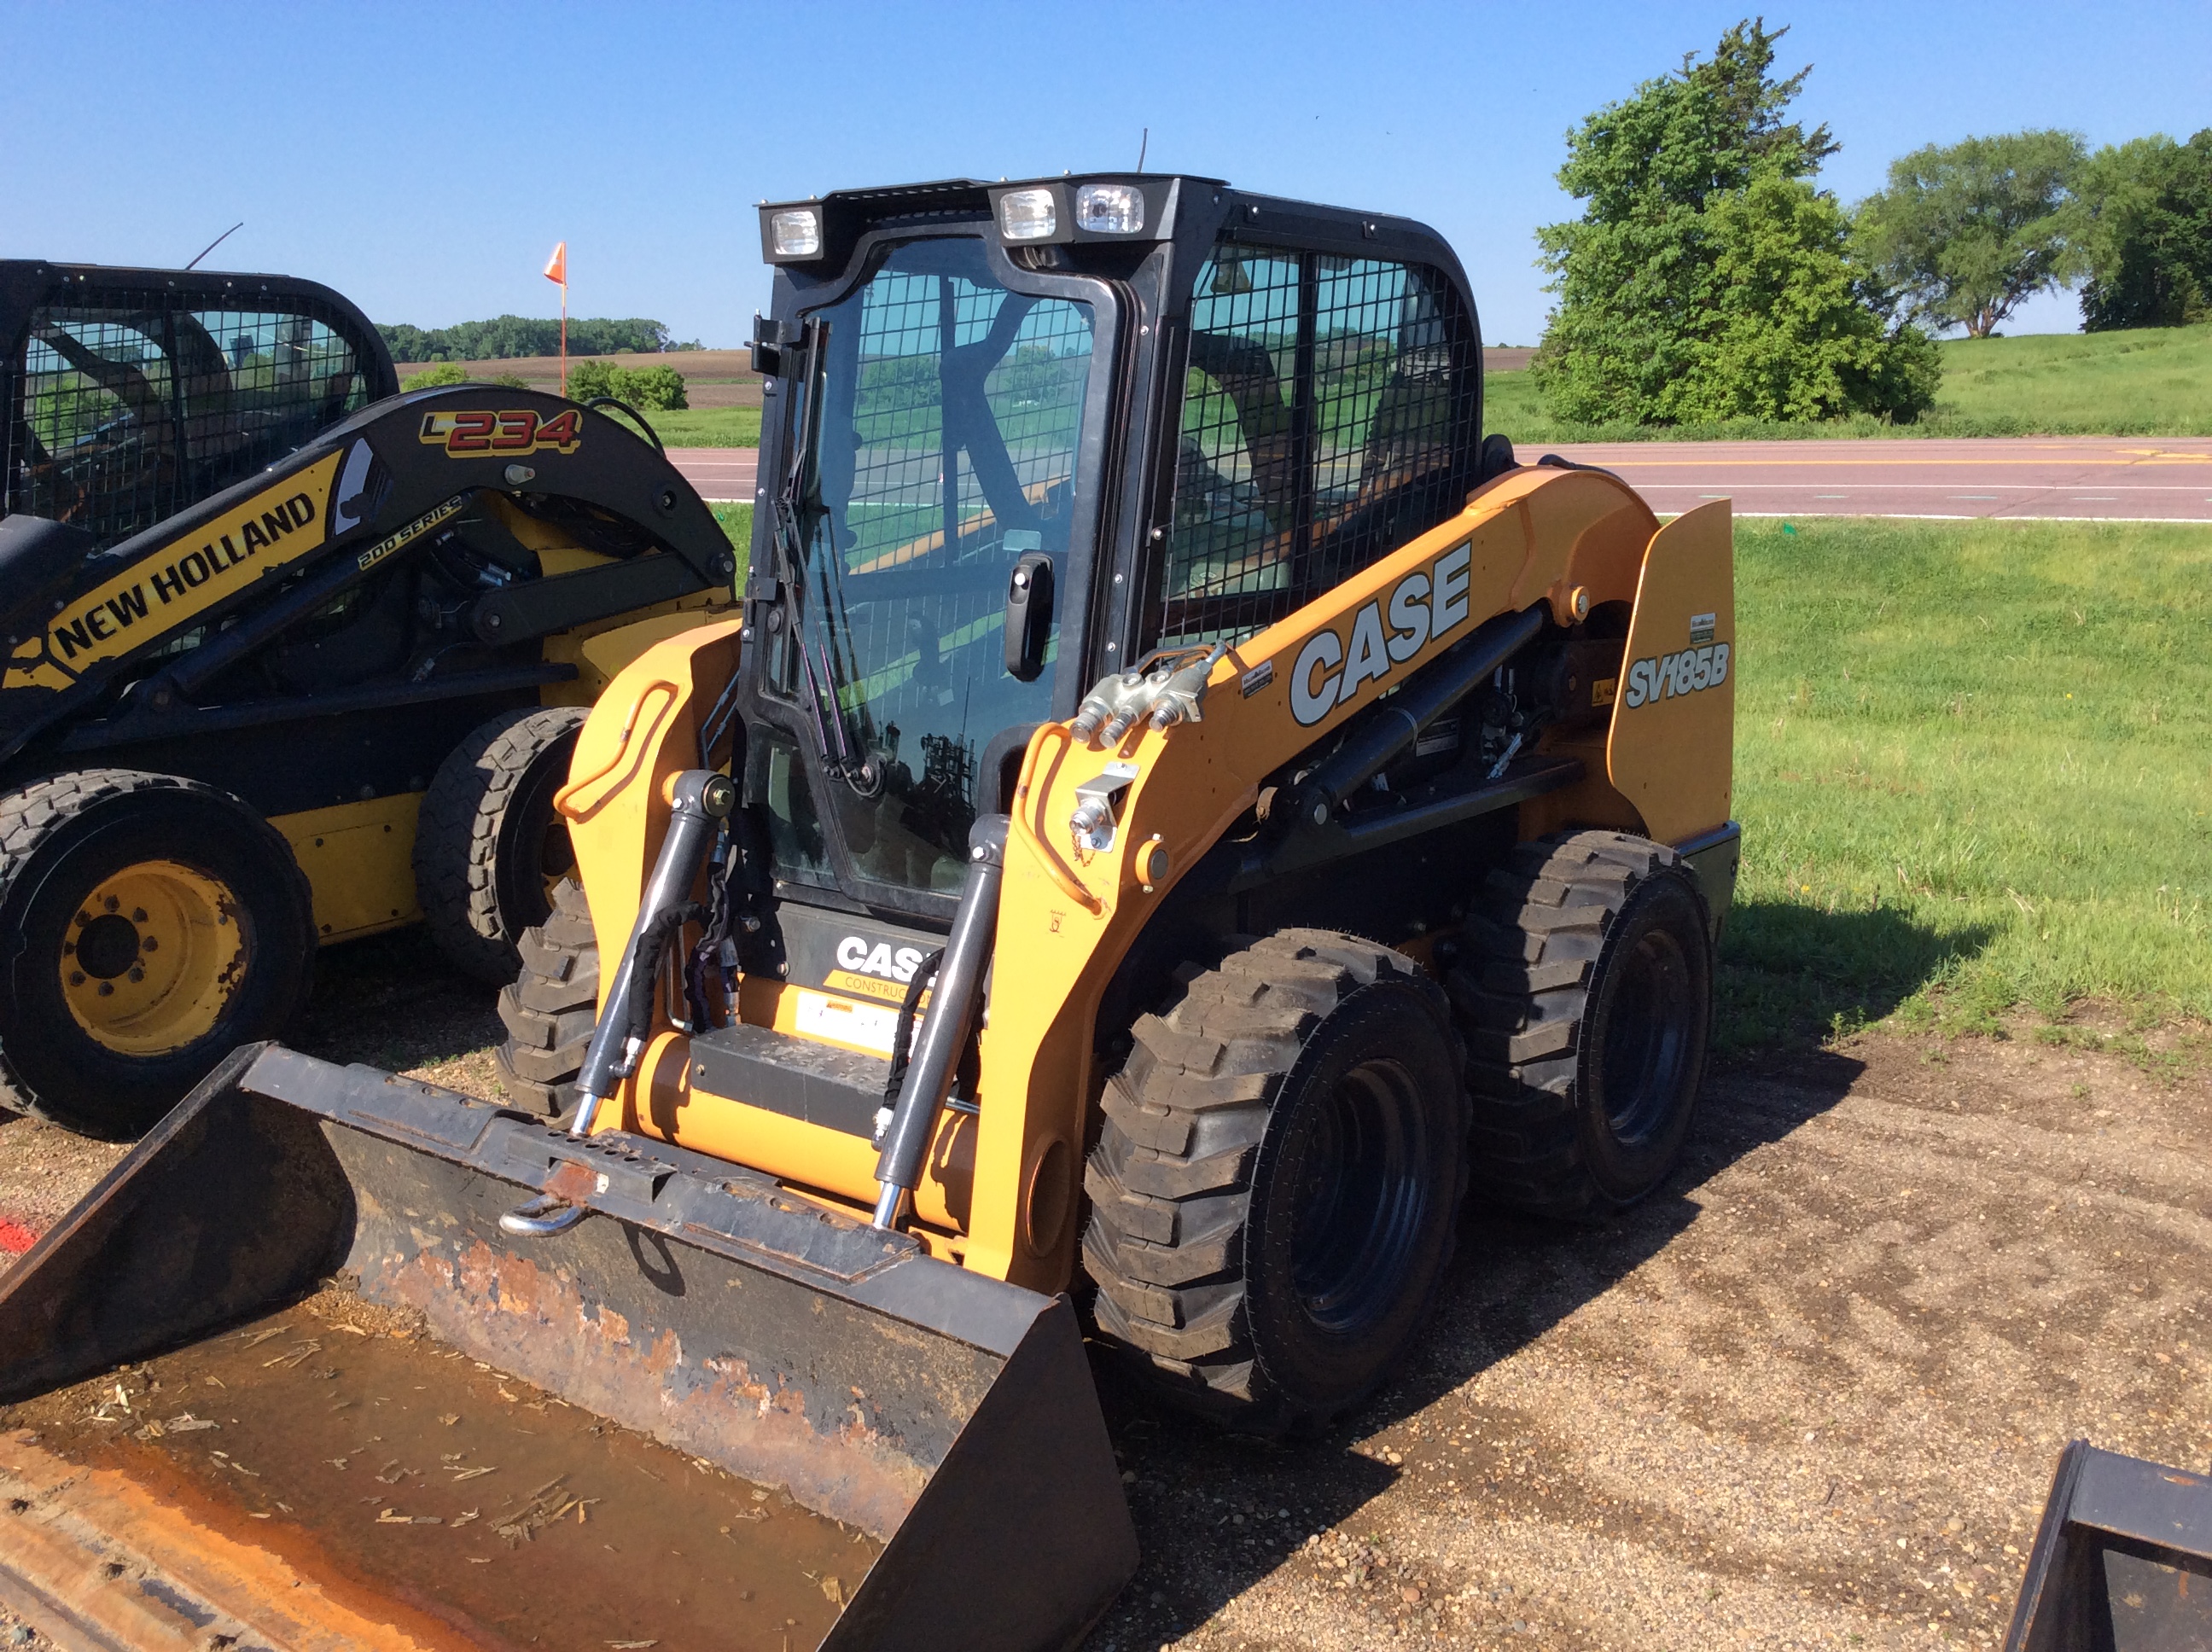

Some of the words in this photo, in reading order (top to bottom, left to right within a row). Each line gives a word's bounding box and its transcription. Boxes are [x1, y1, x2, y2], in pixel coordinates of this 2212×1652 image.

[421, 410, 580, 454] L234
[358, 536, 397, 568] 200
[399, 496, 462, 543] SERIES
[53, 583, 149, 660] NEW
[150, 492, 316, 605] HOLLAND
[1289, 538, 1472, 728] CASE
[1626, 642, 1730, 709] SV185B
[836, 936, 940, 987] CAS
